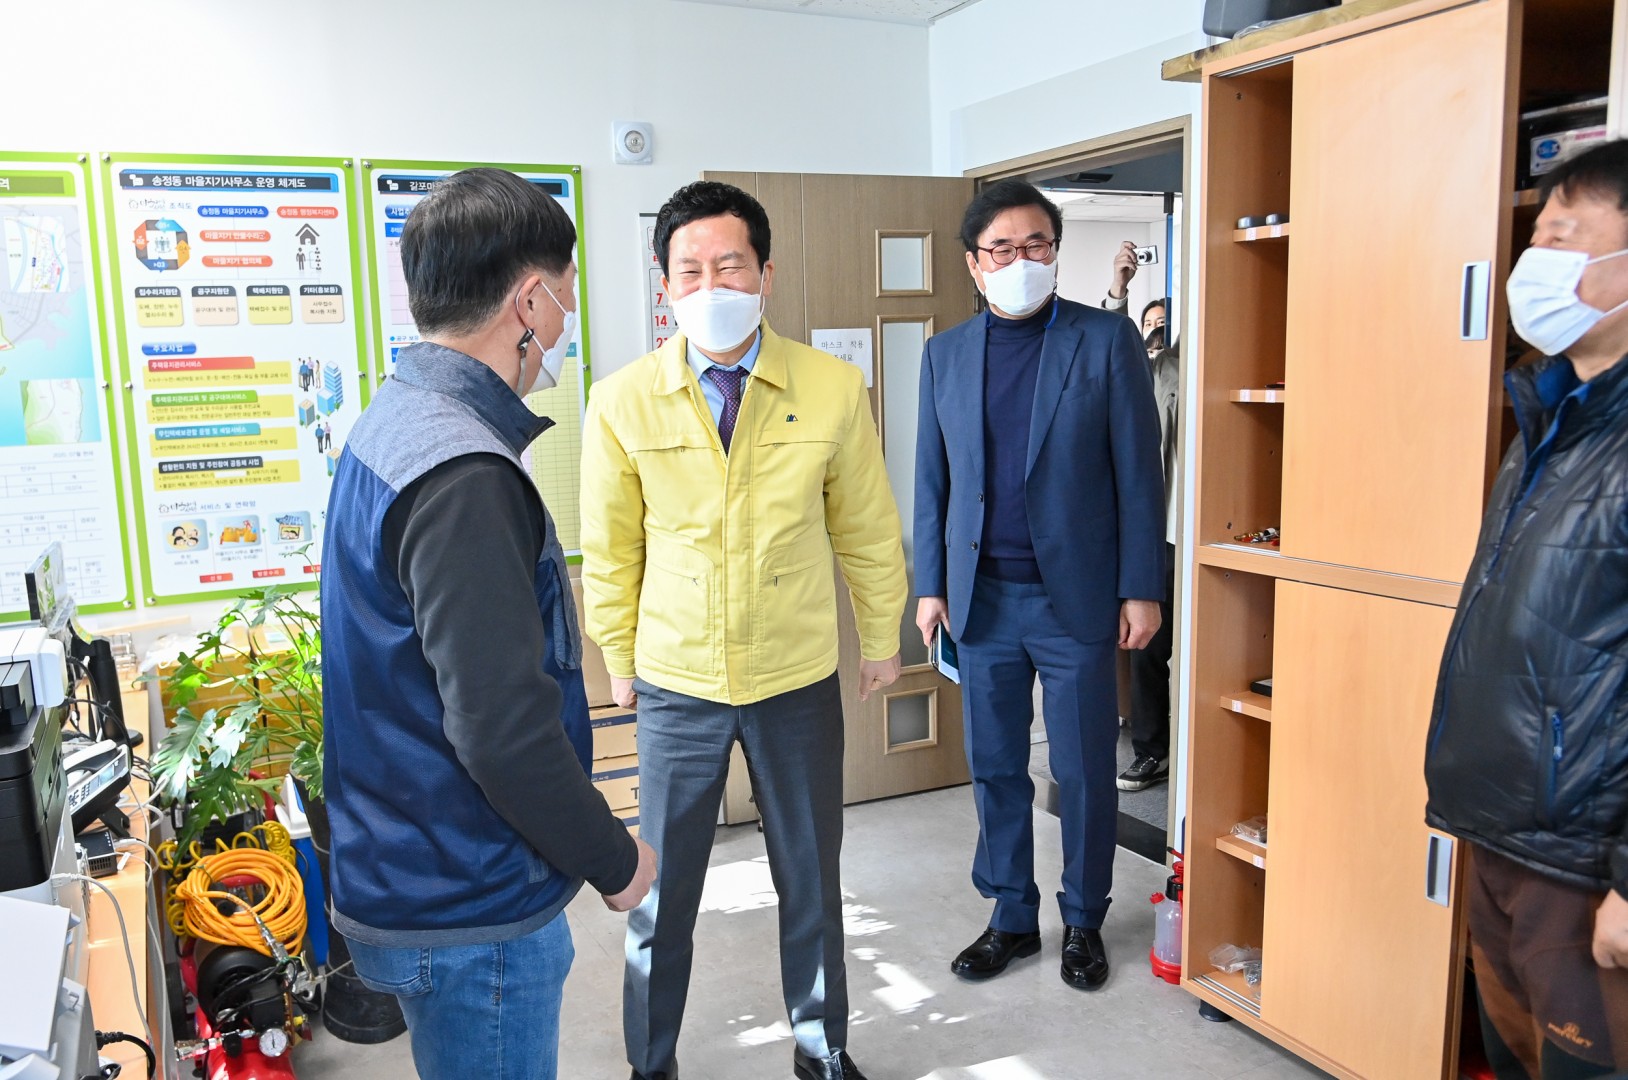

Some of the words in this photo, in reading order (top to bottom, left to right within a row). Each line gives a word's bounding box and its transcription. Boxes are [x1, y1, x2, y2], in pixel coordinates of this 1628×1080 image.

[152, 175, 182, 186] 송정동
[185, 176, 253, 188] 마을지기사무소
[256, 176, 275, 188] 운영
[278, 177, 306, 188] 체계도
[656, 292, 663, 304] 7
[655, 315, 667, 327] 14
[821, 340, 844, 350] 마스크
[850, 340, 864, 349] 착용
